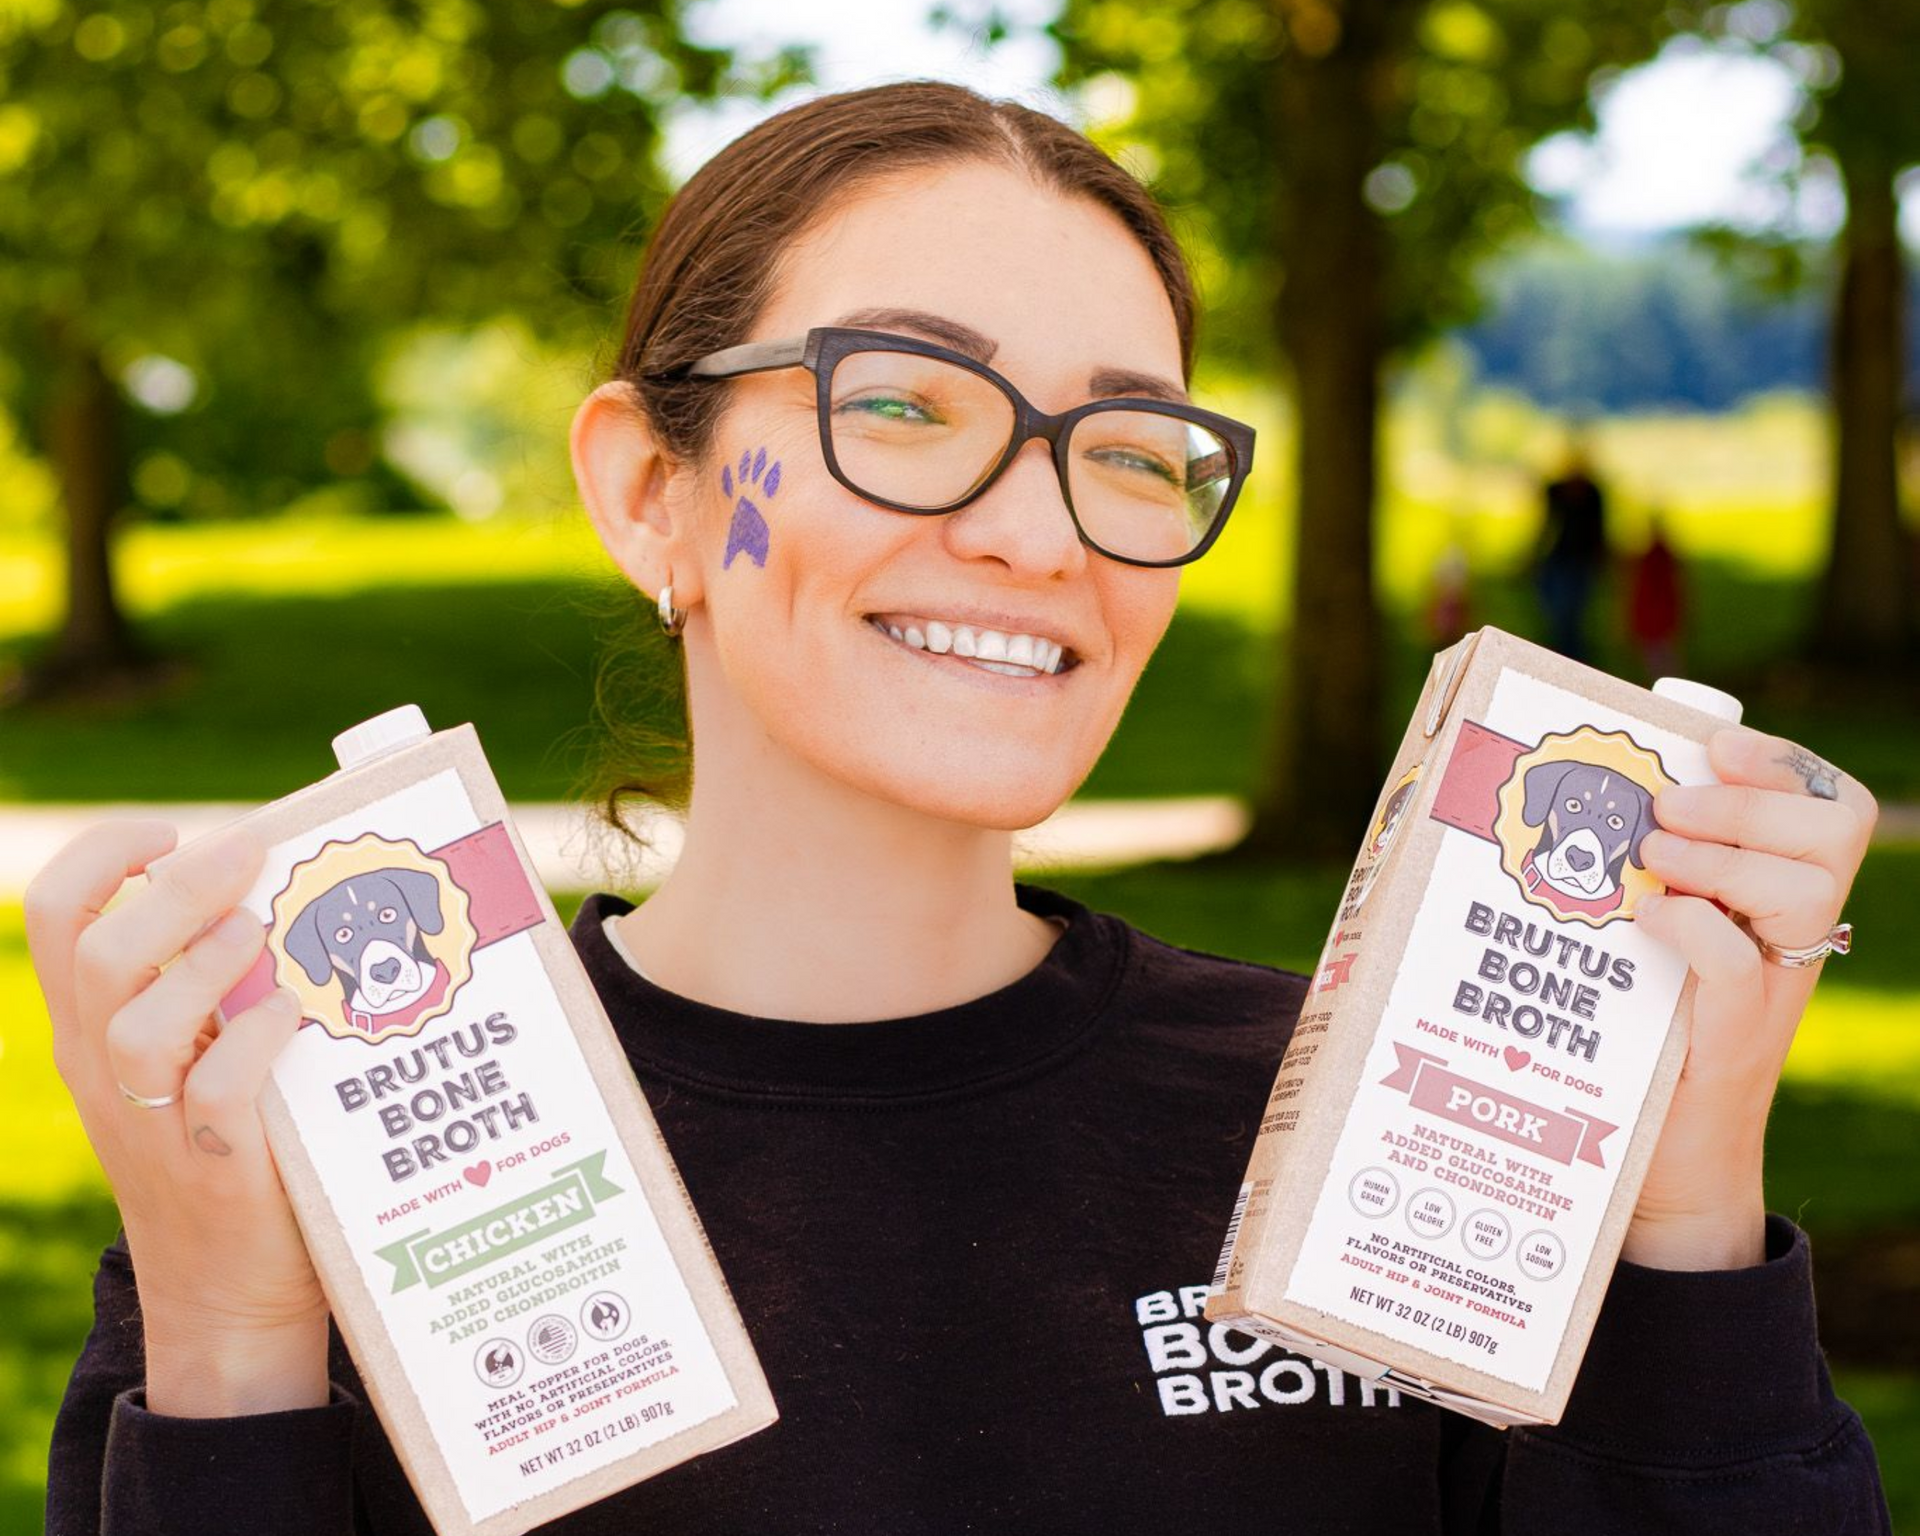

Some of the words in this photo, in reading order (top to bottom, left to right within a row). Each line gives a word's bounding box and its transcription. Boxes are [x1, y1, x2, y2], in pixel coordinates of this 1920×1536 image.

[1464, 901, 1636, 991] BRUTUS
[1452, 980, 1601, 1062] BROTH
[1478, 948, 1601, 1021] BONE
[334, 1011, 518, 1113] BRUTUS
[1416, 1018, 1458, 1042] MADE
[1463, 1036, 1499, 1058] WITH
[1532, 1063, 1561, 1081] FOR
[1564, 1075, 1604, 1098] DOGS
[378, 1060, 509, 1138] BONE
[1446, 1086, 1548, 1143] PORK
[381, 1092, 540, 1183] BROTH
[1381, 1130, 1443, 1161] ADDED
[1448, 1154, 1574, 1212] GLUCOSAMINE
[1412, 1124, 1497, 1166] NATURAL
[1505, 1158, 1554, 1186] WITH
[376, 1198, 421, 1225] MADE
[424, 1180, 463, 1204] WITH
[496, 1153, 527, 1172] FOR
[531, 1132, 571, 1158] DOGS
[1360, 1191, 1386, 1207] GRADE
[1363, 1180, 1390, 1195] HUMAN
[1387, 1150, 1428, 1172] AND
[1434, 1166, 1557, 1222] CHONDROITIN
[1424, 1202, 1442, 1215] LOW
[424, 1186, 584, 1274] CHICKEN
[1370, 1232, 1390, 1246] NO
[1392, 1241, 1462, 1274] ARTIFICIAL
[1413, 1210, 1445, 1228] CALORIE
[1474, 1221, 1503, 1238] GLUTEN
[1474, 1233, 1494, 1247] FREE
[1535, 1243, 1552, 1256] LOW
[430, 1299, 491, 1334] ADDED
[496, 1238, 627, 1302] GLUCOSAMINE
[447, 1260, 537, 1306] NATURAL
[541, 1234, 594, 1264] WITH
[1340, 1253, 1383, 1274] ADULT
[1385, 1269, 1409, 1284] HIP
[1412, 1279, 1421, 1289] &
[1424, 1283, 1463, 1305] JOINT
[1466, 1298, 1527, 1329] FORMULA
[1346, 1236, 1405, 1265] FLAVORS
[1409, 1260, 1428, 1274] OR
[1430, 1269, 1533, 1313] PRESERVATIVES
[1525, 1252, 1554, 1270] SODIUM
[449, 1319, 489, 1344] AND
[493, 1258, 622, 1323] CHONDROITIN
[1350, 1286, 1374, 1306] NET
[1376, 1292, 1395, 1313] WT
[1395, 1303, 1412, 1320] 32
[1413, 1310, 1431, 1327] OZ
[1431, 1315, 1446, 1333] (2
[1446, 1322, 1467, 1342] LB)
[1468, 1330, 1499, 1355] 907g
[475, 1410, 511, 1431] WITH
[515, 1399, 535, 1415] NO
[539, 1364, 615, 1403] ARTIFICIAL
[484, 1407, 543, 1441] FLAVORS
[546, 1394, 565, 1411] OR
[568, 1352, 673, 1403] PRESERVATIVES
[487, 1390, 526, 1413] MEAL
[529, 1365, 580, 1392] TOPPER
[583, 1352, 610, 1368] FOR
[613, 1335, 649, 1356] DOGS
[488, 1431, 530, 1456] ADULT
[533, 1418, 557, 1435] HIP
[560, 1412, 569, 1423] &
[573, 1395, 612, 1418] JOINT
[616, 1365, 680, 1398] FORMULA
[520, 1456, 544, 1477] NET
[543, 1447, 565, 1466] WT
[566, 1439, 584, 1457] 32
[586, 1430, 603, 1448] OZ
[603, 1425, 618, 1441] (2
[618, 1413, 641, 1434] LB)
[643, 1401, 675, 1424] 907g
